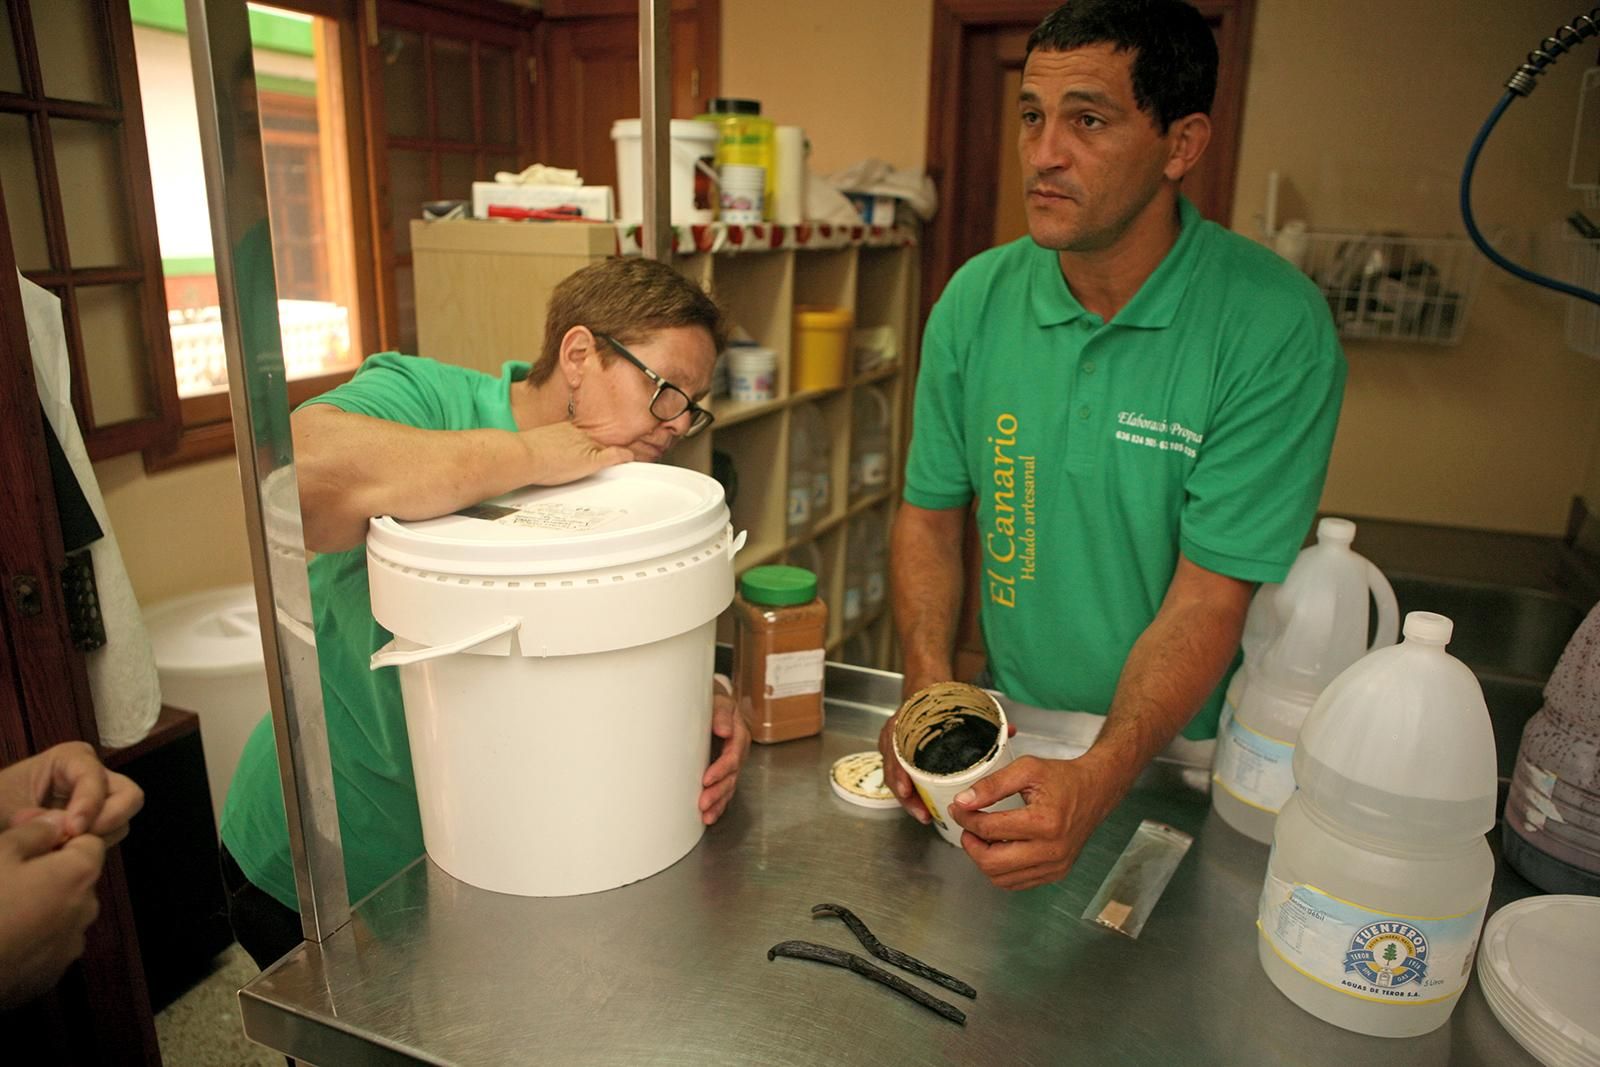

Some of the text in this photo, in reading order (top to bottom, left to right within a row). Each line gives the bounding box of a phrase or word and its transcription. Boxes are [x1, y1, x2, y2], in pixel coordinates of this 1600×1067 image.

[987, 413, 1018, 608] El Canario
[1018, 455, 1036, 580] Helado artesanal
[1355, 923, 1426, 953] FUENTEROR
[1350, 952, 1370, 961] TEROR
[1341, 979, 1367, 992] AGUAS
[1369, 986, 1380, 995] DE
